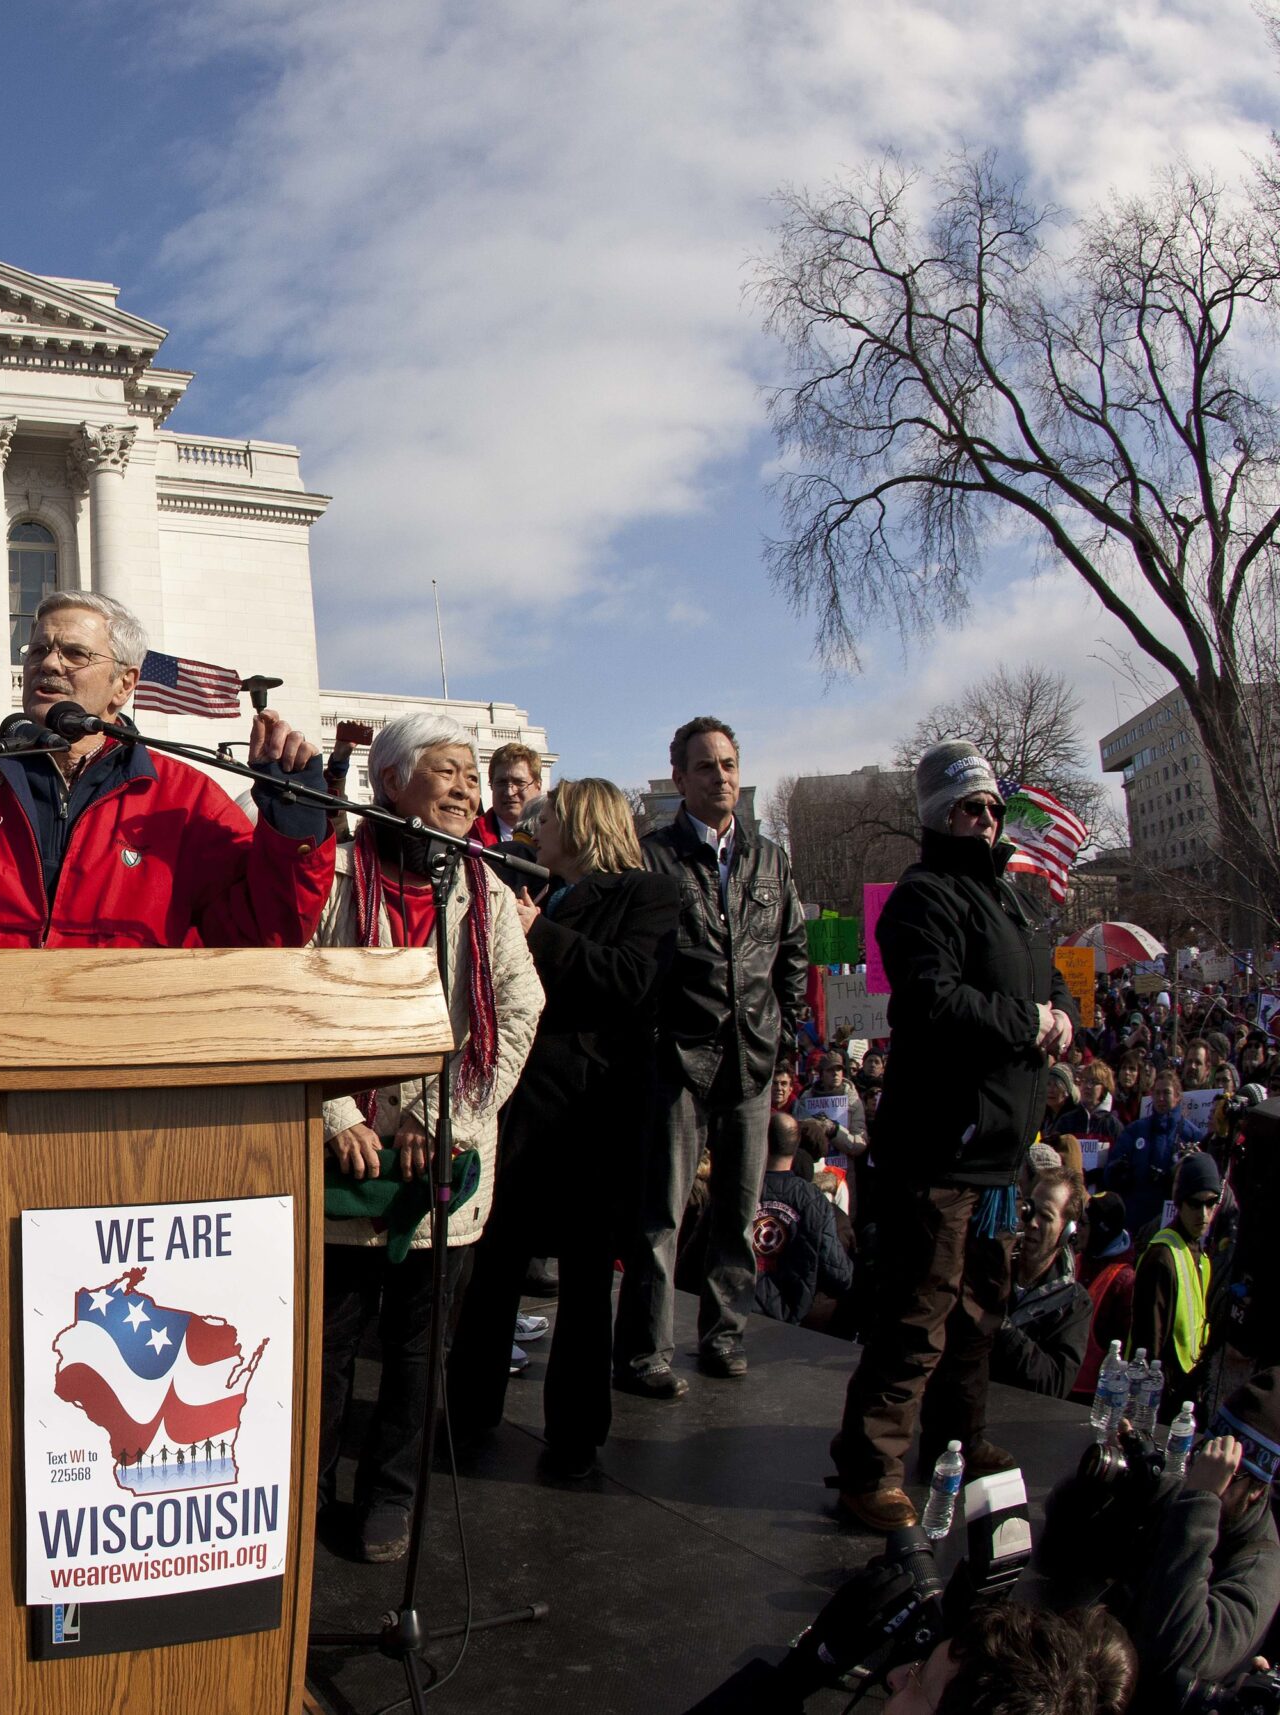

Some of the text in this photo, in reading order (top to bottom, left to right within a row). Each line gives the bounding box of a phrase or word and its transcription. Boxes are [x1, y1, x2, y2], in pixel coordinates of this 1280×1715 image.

[831, 981, 867, 999] THA
[807, 1097, 847, 1109] THANK YOU!
[95, 1212, 233, 1265] WE ARE
[46, 1449, 98, 1466] Text WI to
[50, 1467, 92, 1484] 225568
[38, 1484, 280, 1560] WISCONSIN
[49, 1543, 269, 1590] wearewisconsin.org
